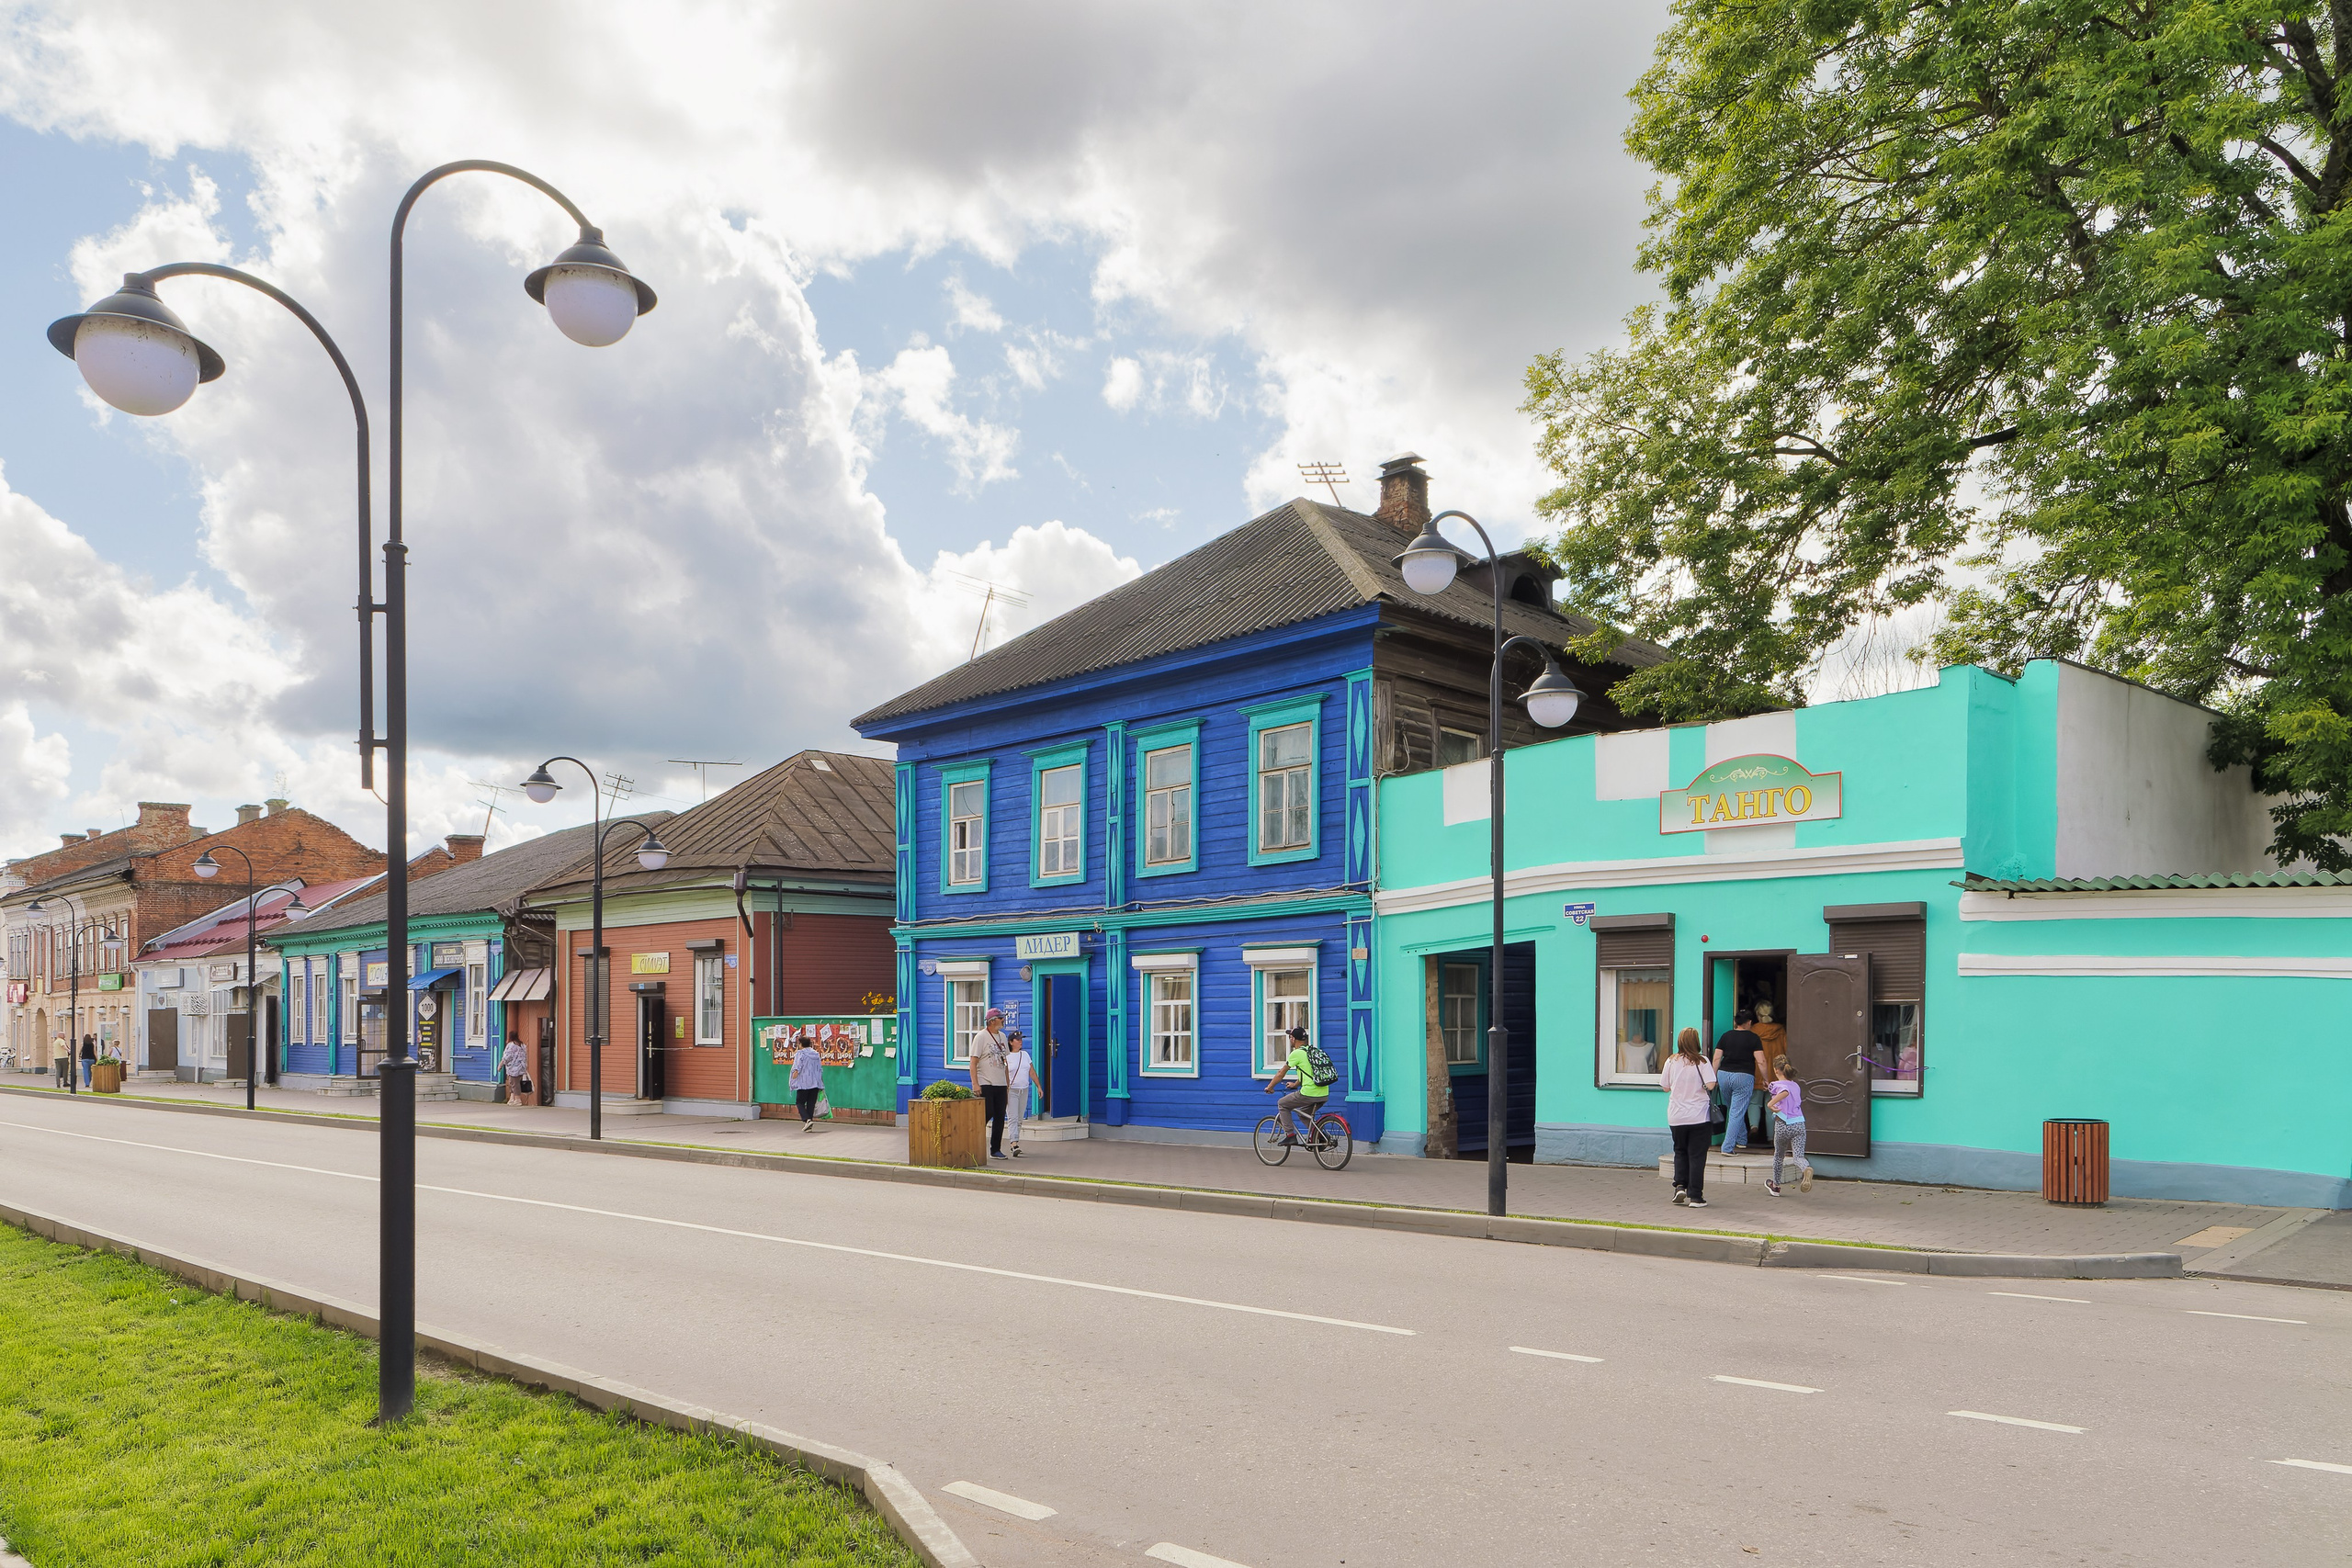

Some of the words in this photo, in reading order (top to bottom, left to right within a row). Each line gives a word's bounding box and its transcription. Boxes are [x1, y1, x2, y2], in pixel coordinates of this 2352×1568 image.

[1687, 785, 1812, 824] ТАНГО
[1024, 935, 1071, 956] ЛИДЕР
[639, 956, 668, 973] СИЛУЭТ
[774, 1051, 787, 1059] ЦИРК
[821, 1052, 835, 1060] ЦИРК
